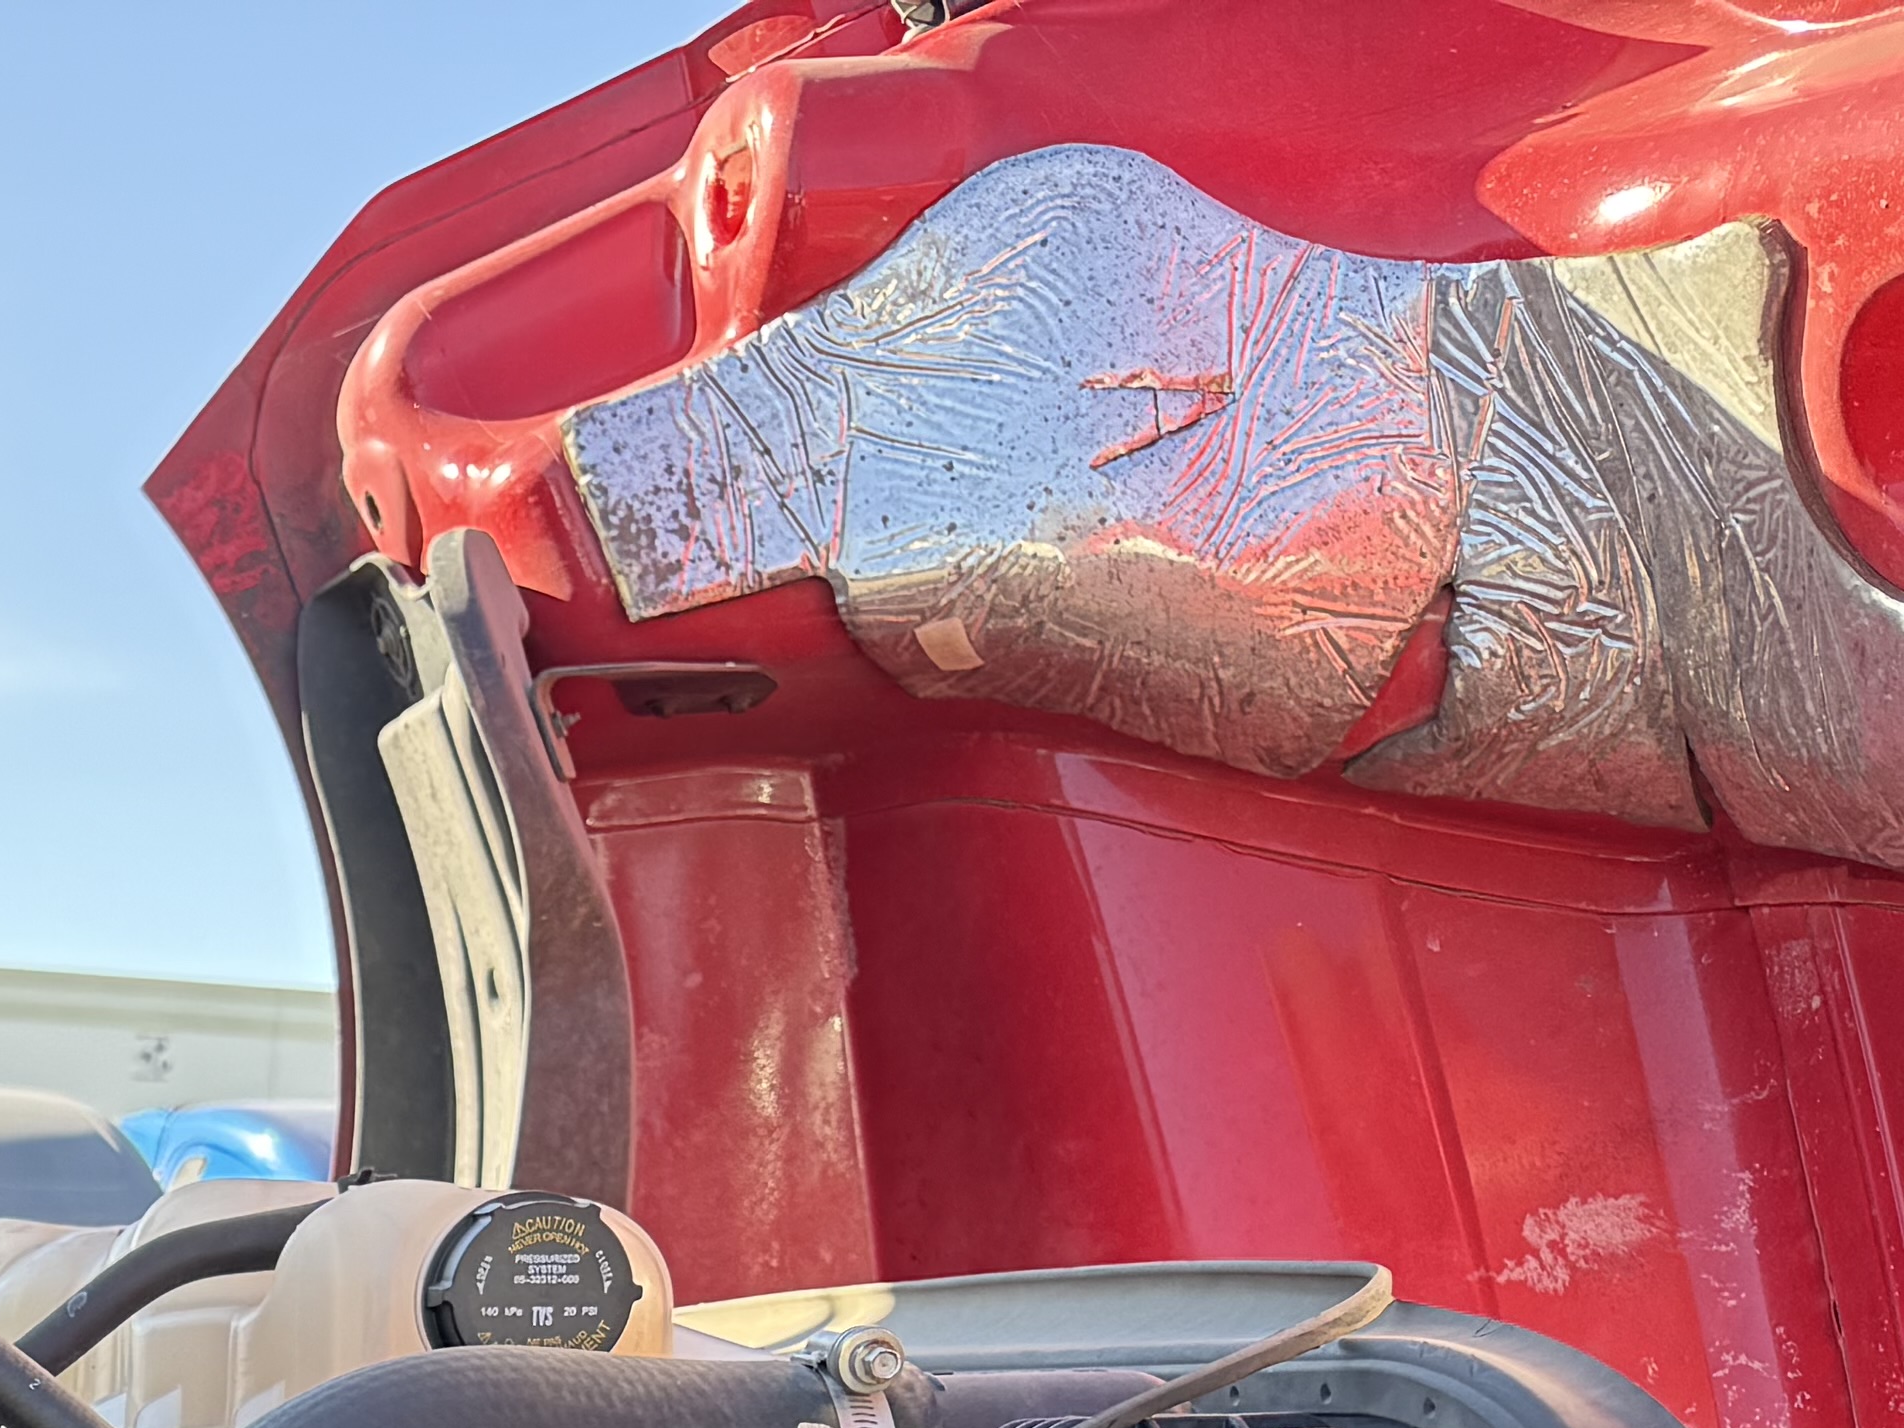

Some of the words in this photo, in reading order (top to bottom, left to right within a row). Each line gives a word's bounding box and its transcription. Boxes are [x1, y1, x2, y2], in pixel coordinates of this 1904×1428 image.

[526, 1216, 585, 1237] CAUTION
[508, 1233, 541, 1254] NEVER
[515, 1254, 580, 1263] PRESSURIZED
[528, 1265, 566, 1274] SYSTEM
[532, 1306, 553, 1326] TVS
[564, 1307, 576, 1316] 20
[582, 1307, 597, 1315] PSI
